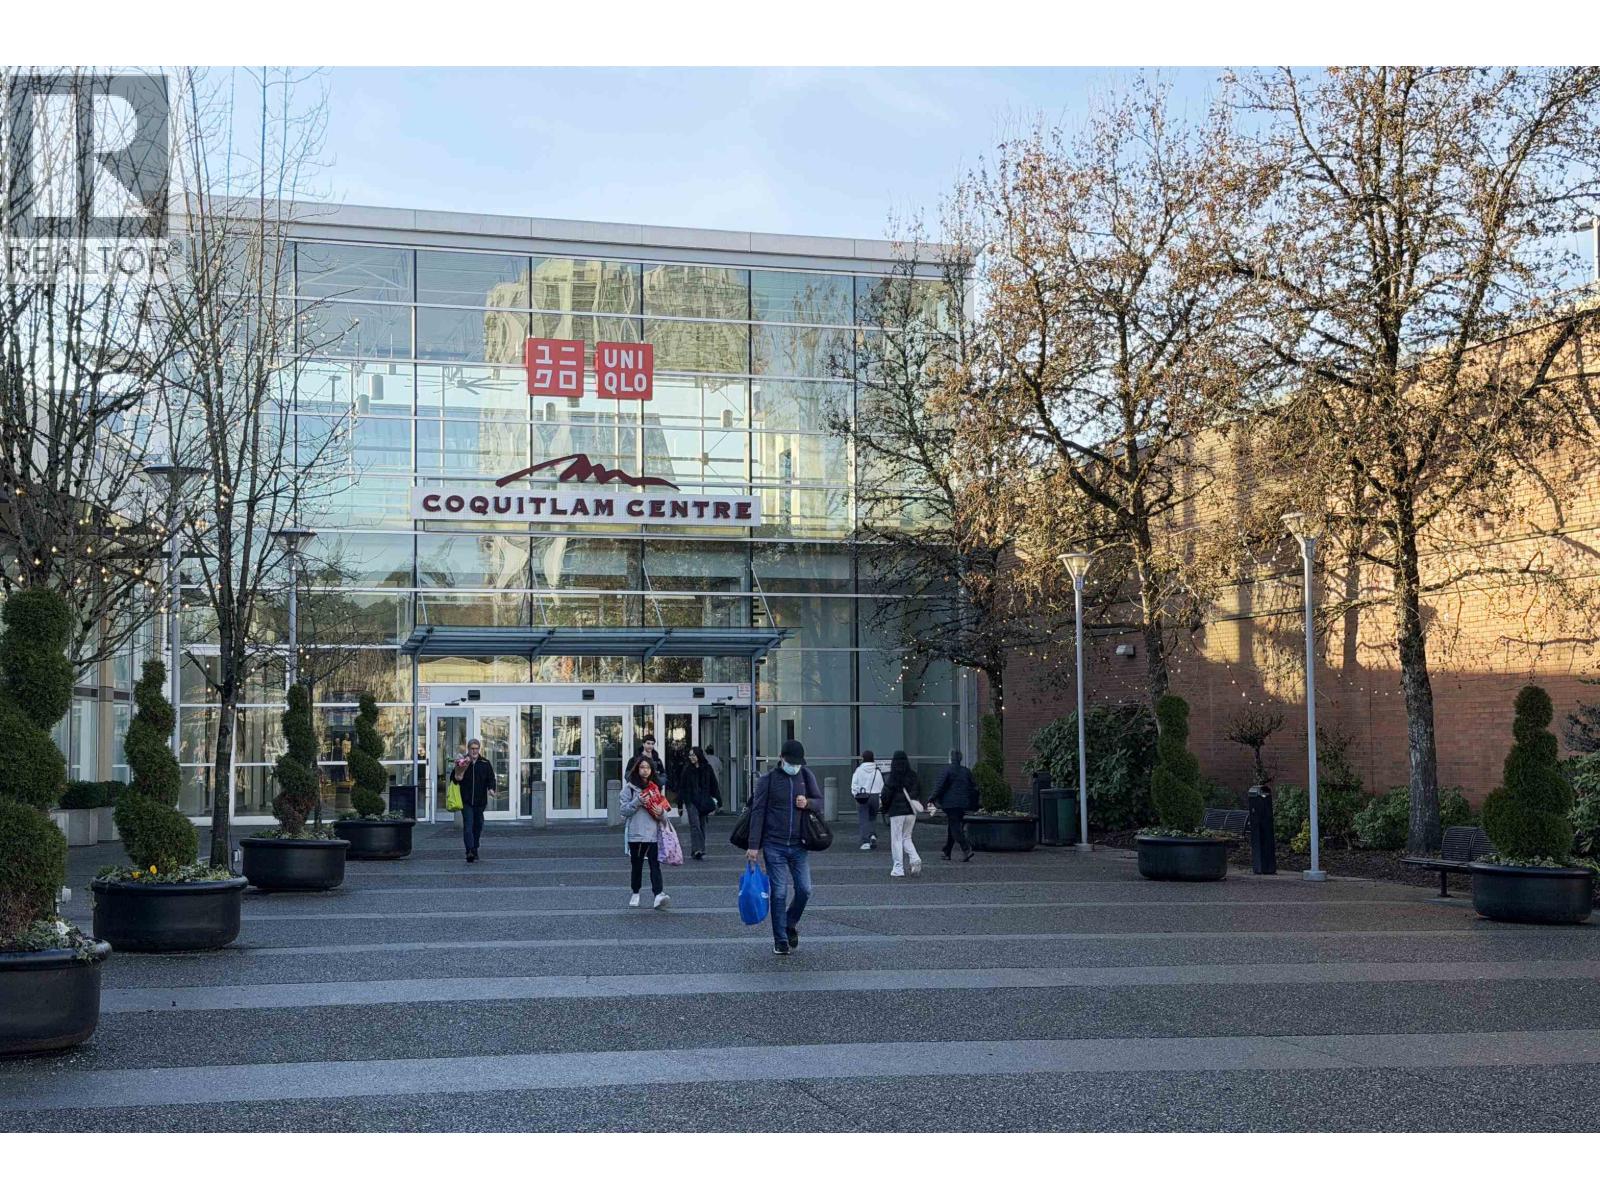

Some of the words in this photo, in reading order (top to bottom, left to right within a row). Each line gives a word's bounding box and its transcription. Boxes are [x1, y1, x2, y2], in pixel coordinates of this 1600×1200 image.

[604, 349, 643, 369] UNI
[604, 372, 647, 394] QLO
[422, 494, 614, 517] COQUITLAM
[626, 500, 752, 519] CENTRE
